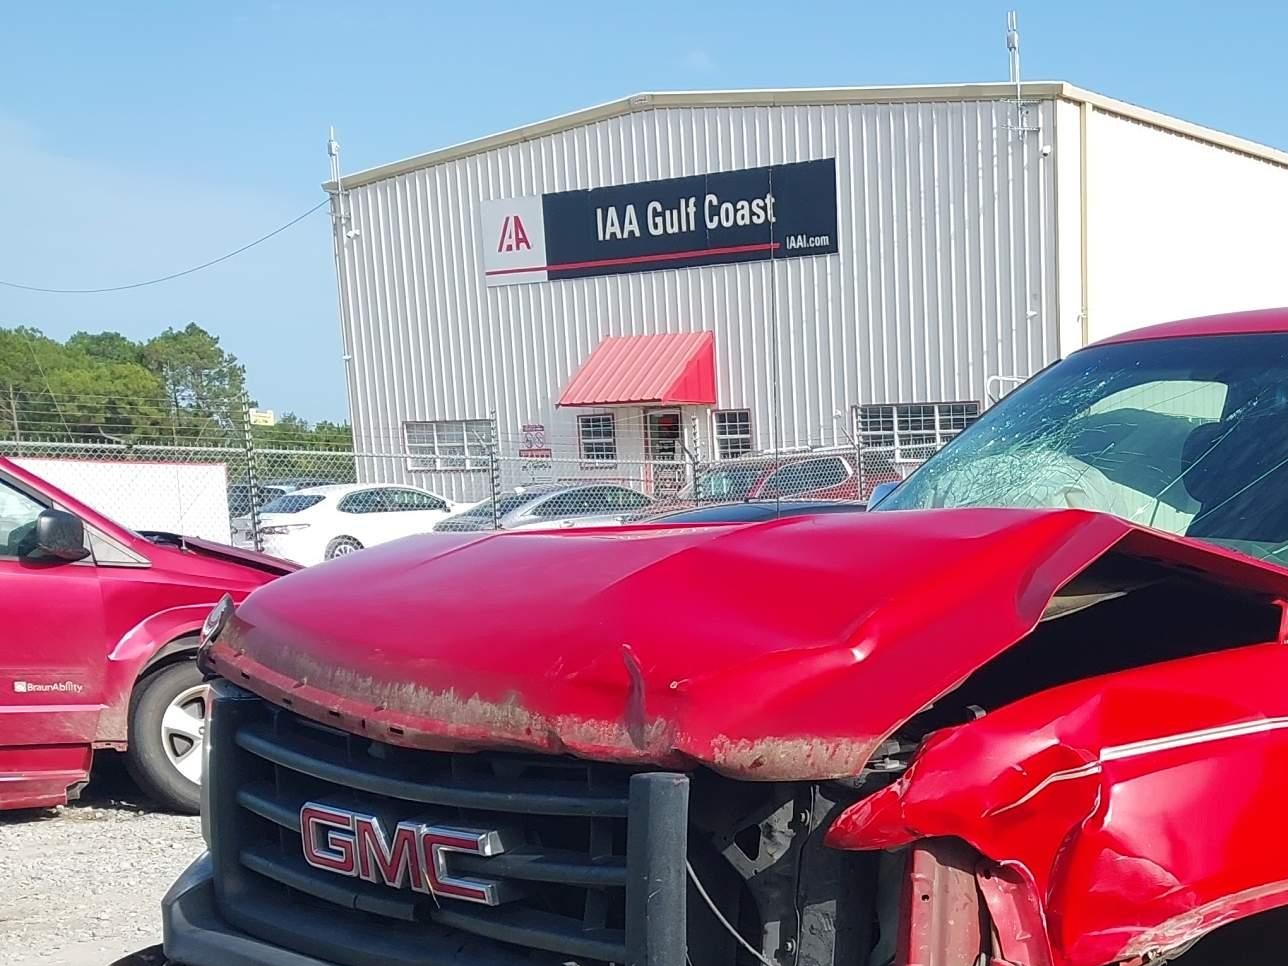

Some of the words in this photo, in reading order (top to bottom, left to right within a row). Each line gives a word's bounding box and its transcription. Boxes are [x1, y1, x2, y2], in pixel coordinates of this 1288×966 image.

[597, 204, 641, 241] IAA
[647, 196, 697, 236] Gulf
[704, 192, 776, 229] Coast
[786, 234, 829, 250] IAAI.com
[27, 680, 83, 693] BraunAbility
[301, 802, 504, 906] GMC
